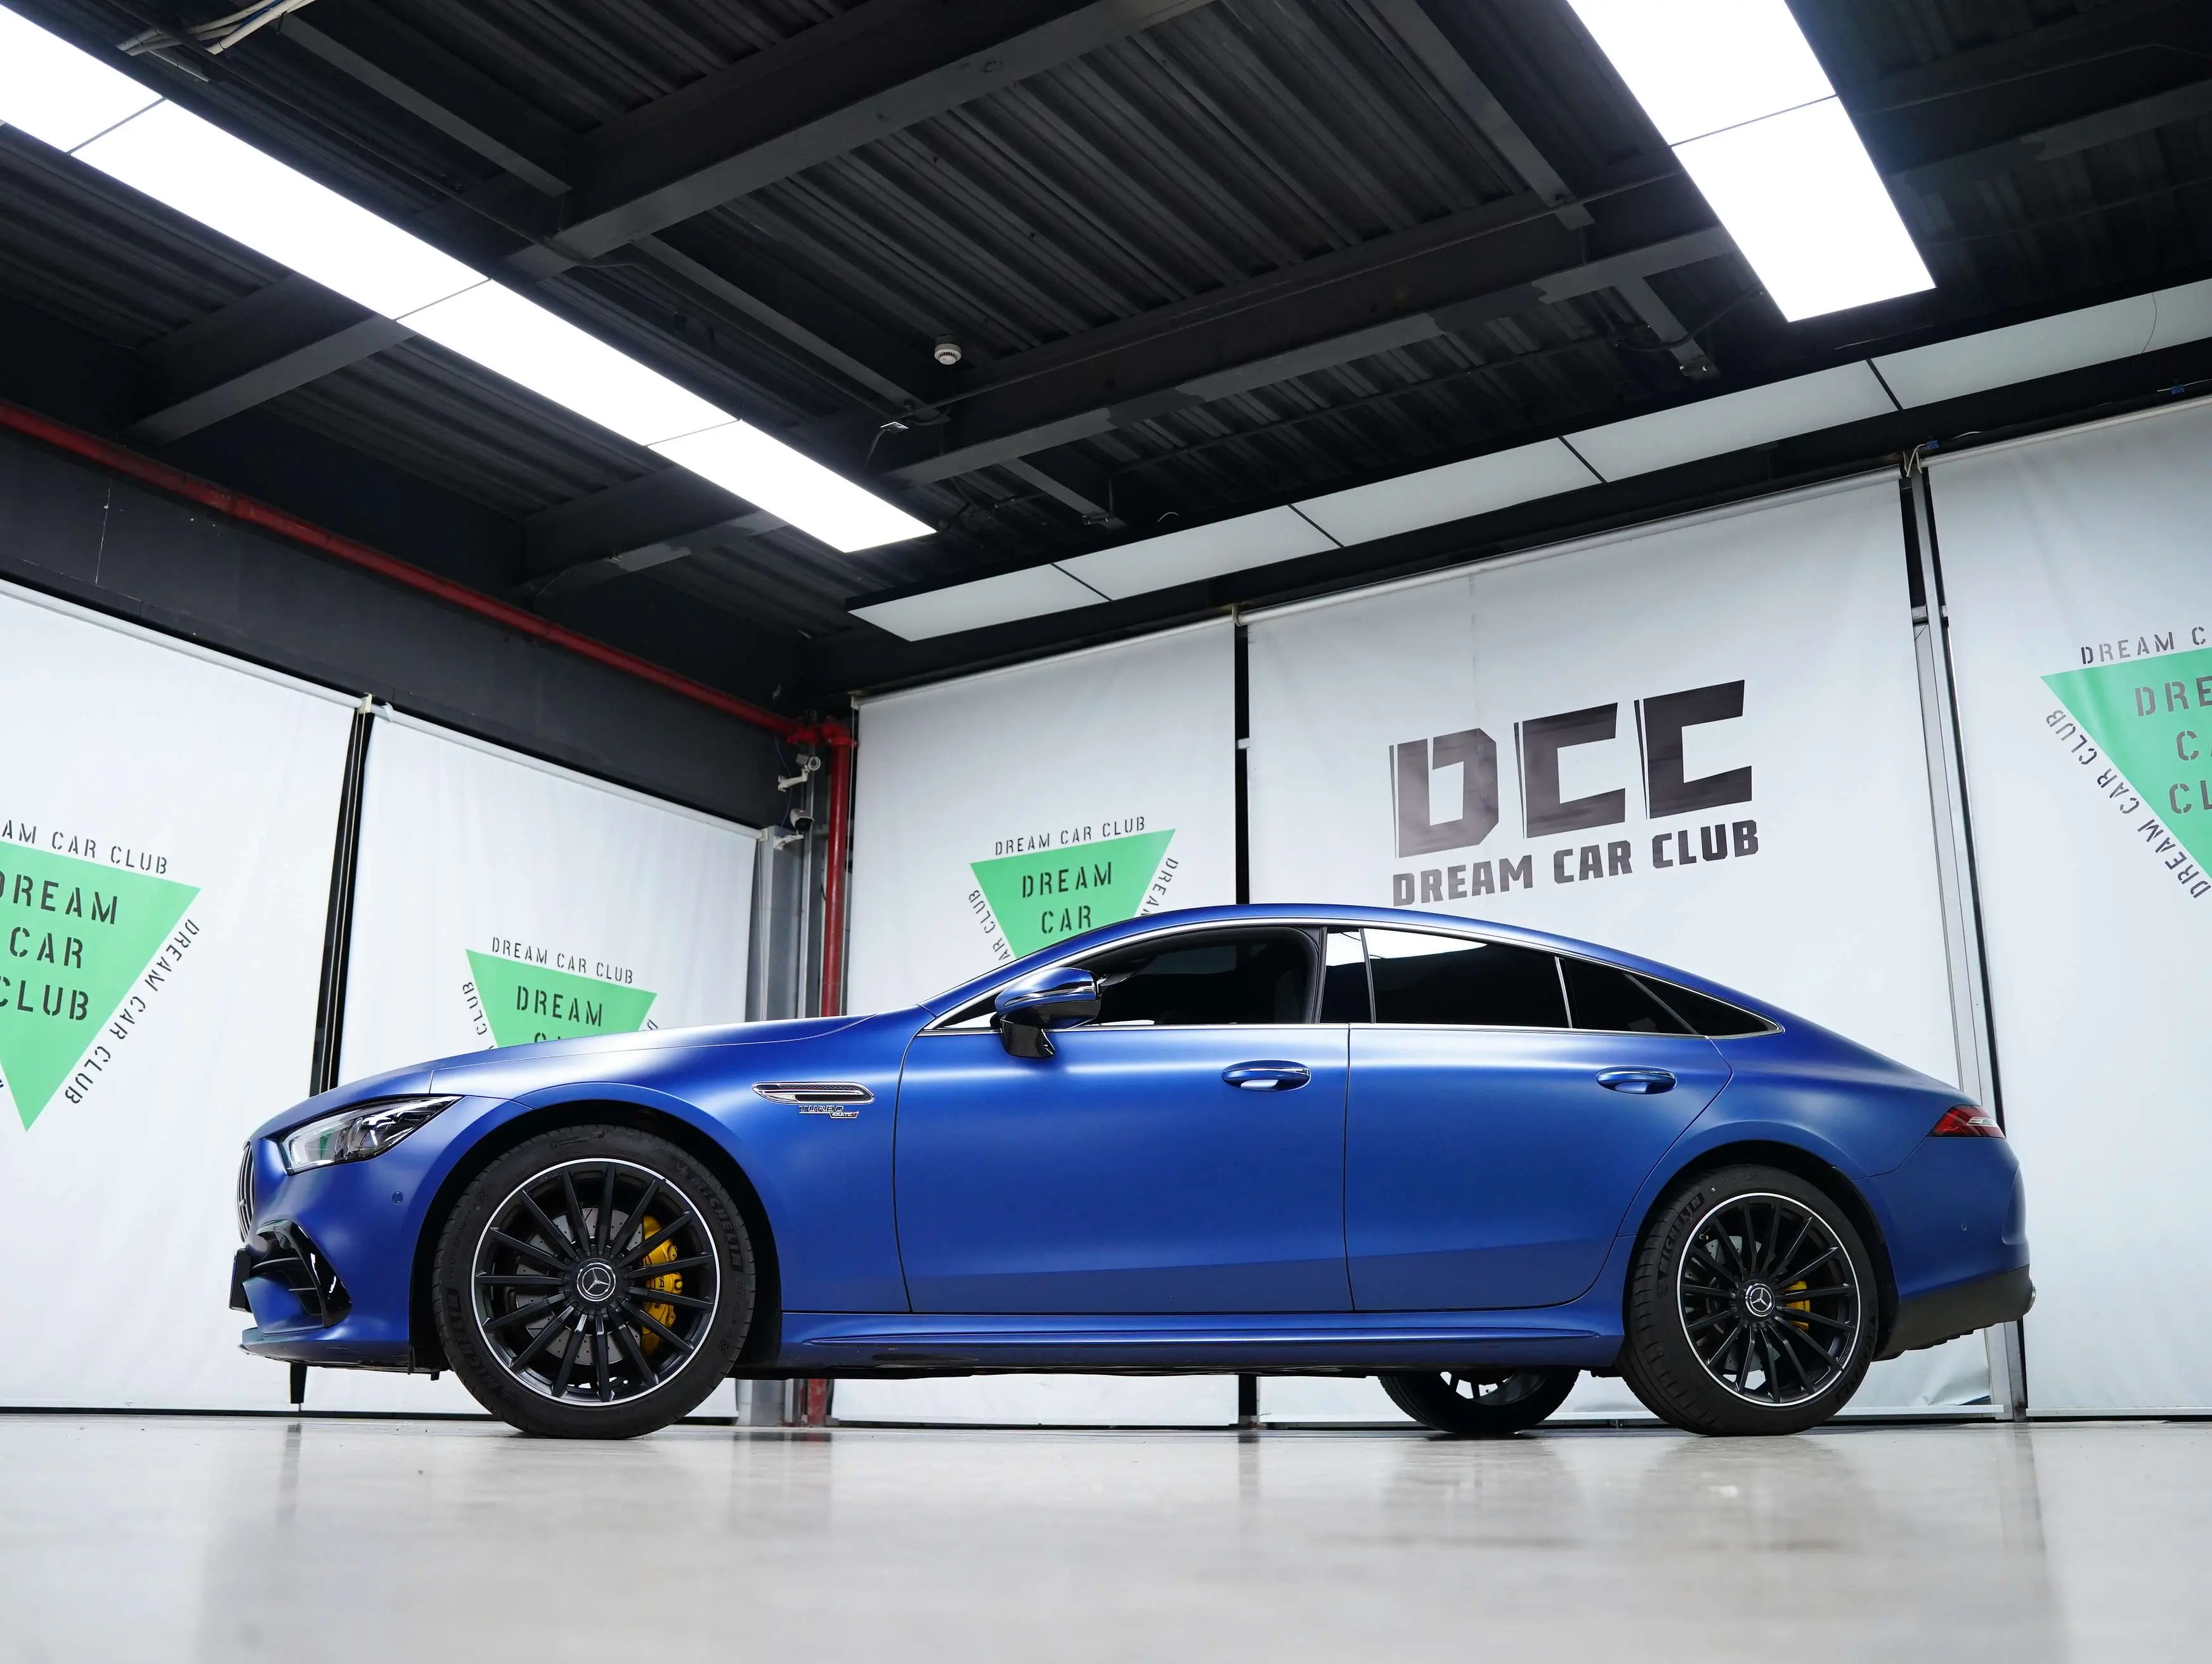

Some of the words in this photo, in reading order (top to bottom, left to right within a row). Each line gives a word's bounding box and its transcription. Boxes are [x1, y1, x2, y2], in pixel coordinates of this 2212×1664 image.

[2081, 632, 2175, 665] DREAM
[2046, 709, 2097, 765] CLUB
[1389, 679, 1752, 858] DCC
[2097, 768, 2140, 814] CAR
[51, 831, 96, 859] CAR
[110, 845, 167, 874] CLUB
[996, 833, 1050, 855] DREAM
[1060, 826, 1091, 845] CAR
[1102, 816, 1145, 837] CLUB
[2137, 819, 2211, 899] DREAM
[1022, 862, 1111, 899] DREAM
[1393, 854, 1533, 907] DREAM
[1553, 840, 1633, 884] CAR
[1651, 819, 1759, 869] CLUB
[0, 871, 118, 925] REAM
[968, 890, 996, 933] CLUB
[1041, 905, 1091, 934] CAR
[10, 926, 83, 969] CAR
[144, 919, 200, 992] DREAM
[492, 937, 547, 965] DREAM
[557, 953, 587, 973] CAR
[596, 962, 633, 984] CLUB
[109, 996, 146, 1039] CAR
[462, 982, 487, 1036] CLUB
[516, 985, 602, 1027] DREAM
[65, 1046, 111, 1104] CLUB
[689, 1175, 742, 1270] MICHELIN
[1659, 1193, 1703, 1274] MICHELIN
